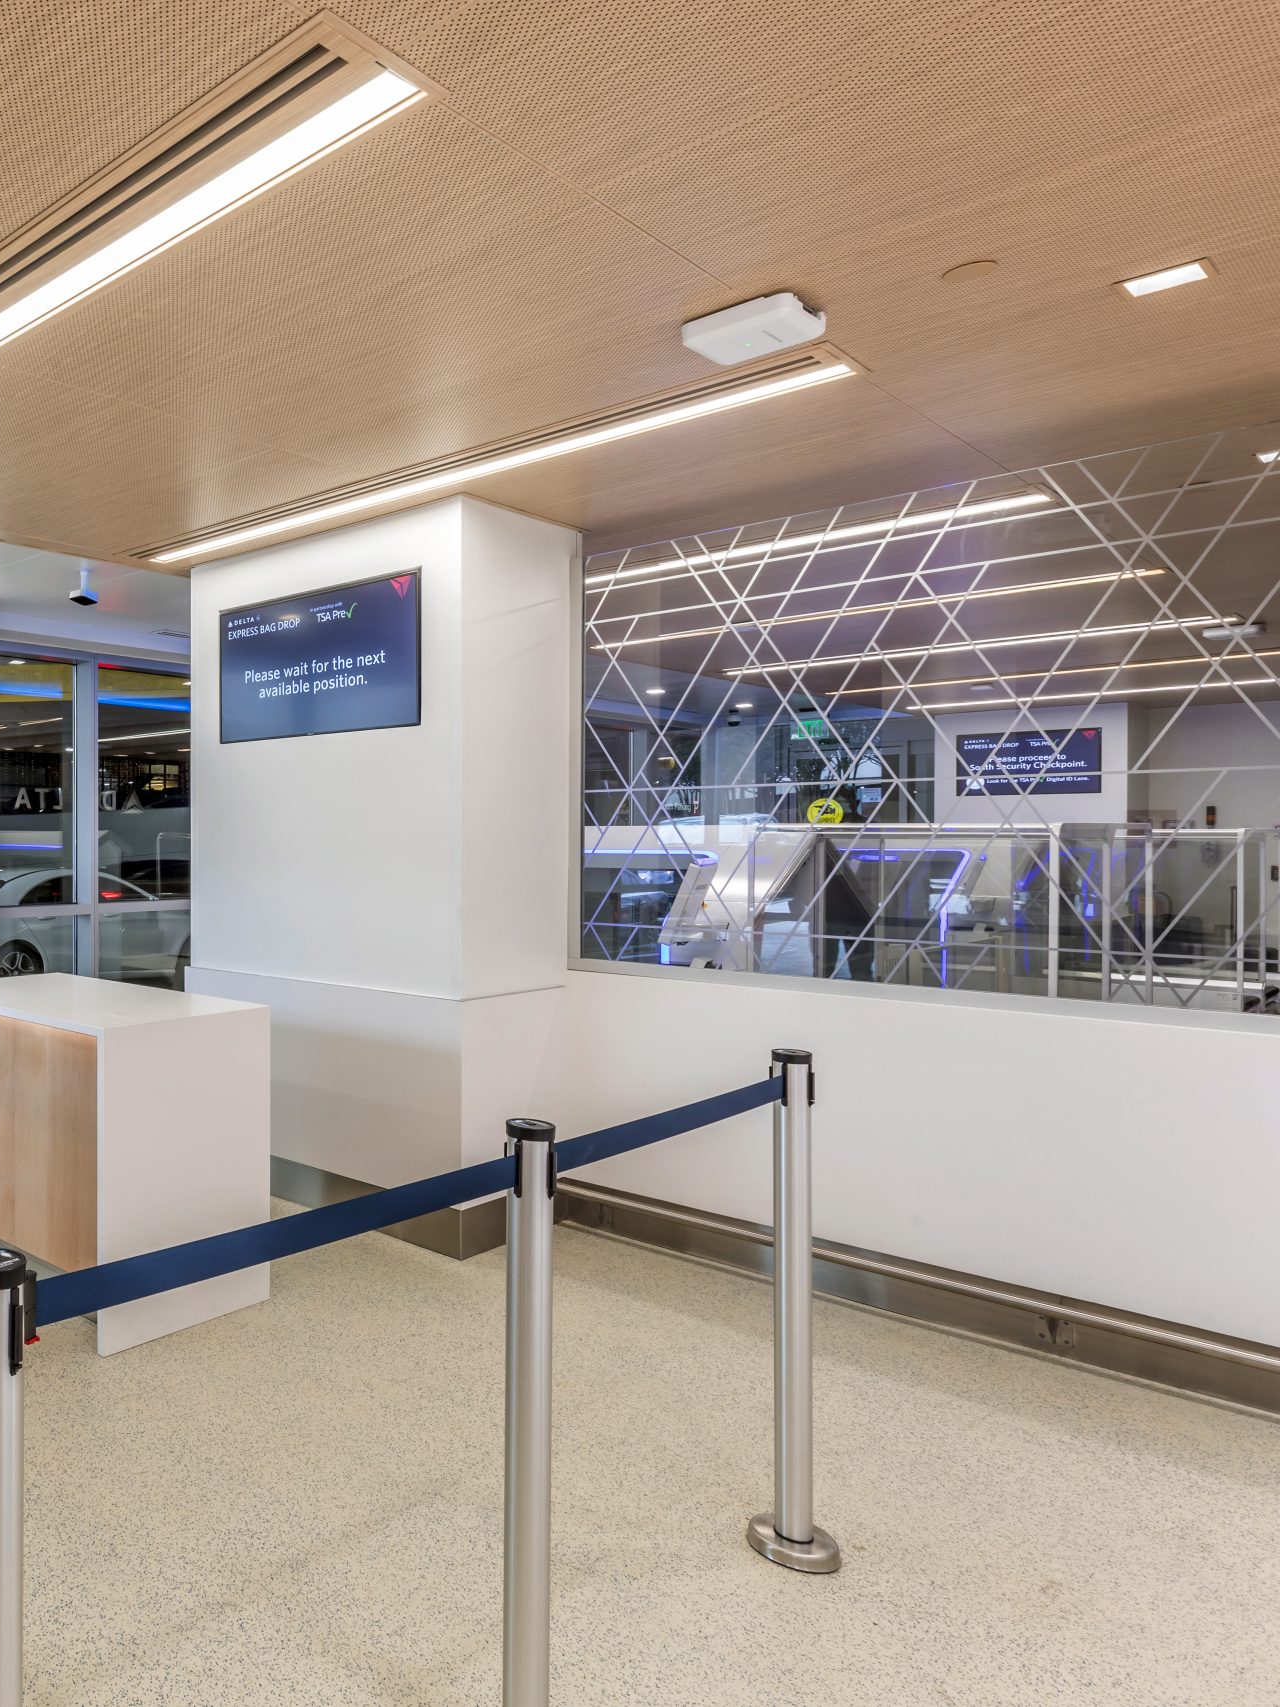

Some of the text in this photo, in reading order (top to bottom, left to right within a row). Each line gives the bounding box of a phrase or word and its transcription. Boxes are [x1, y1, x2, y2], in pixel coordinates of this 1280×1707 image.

[234, 616, 255, 626] DELTA
[316, 609, 346, 622] TSA Pre
[228, 617, 300, 640] EXPRESS BAG DROP
[244, 650, 385, 684] Please wait for the next
[259, 673, 368, 699] available position.
[970, 763, 994, 771] Soth
[1033, 760, 1088, 769] Chckpoint.
[989, 755, 1017, 763] ease
